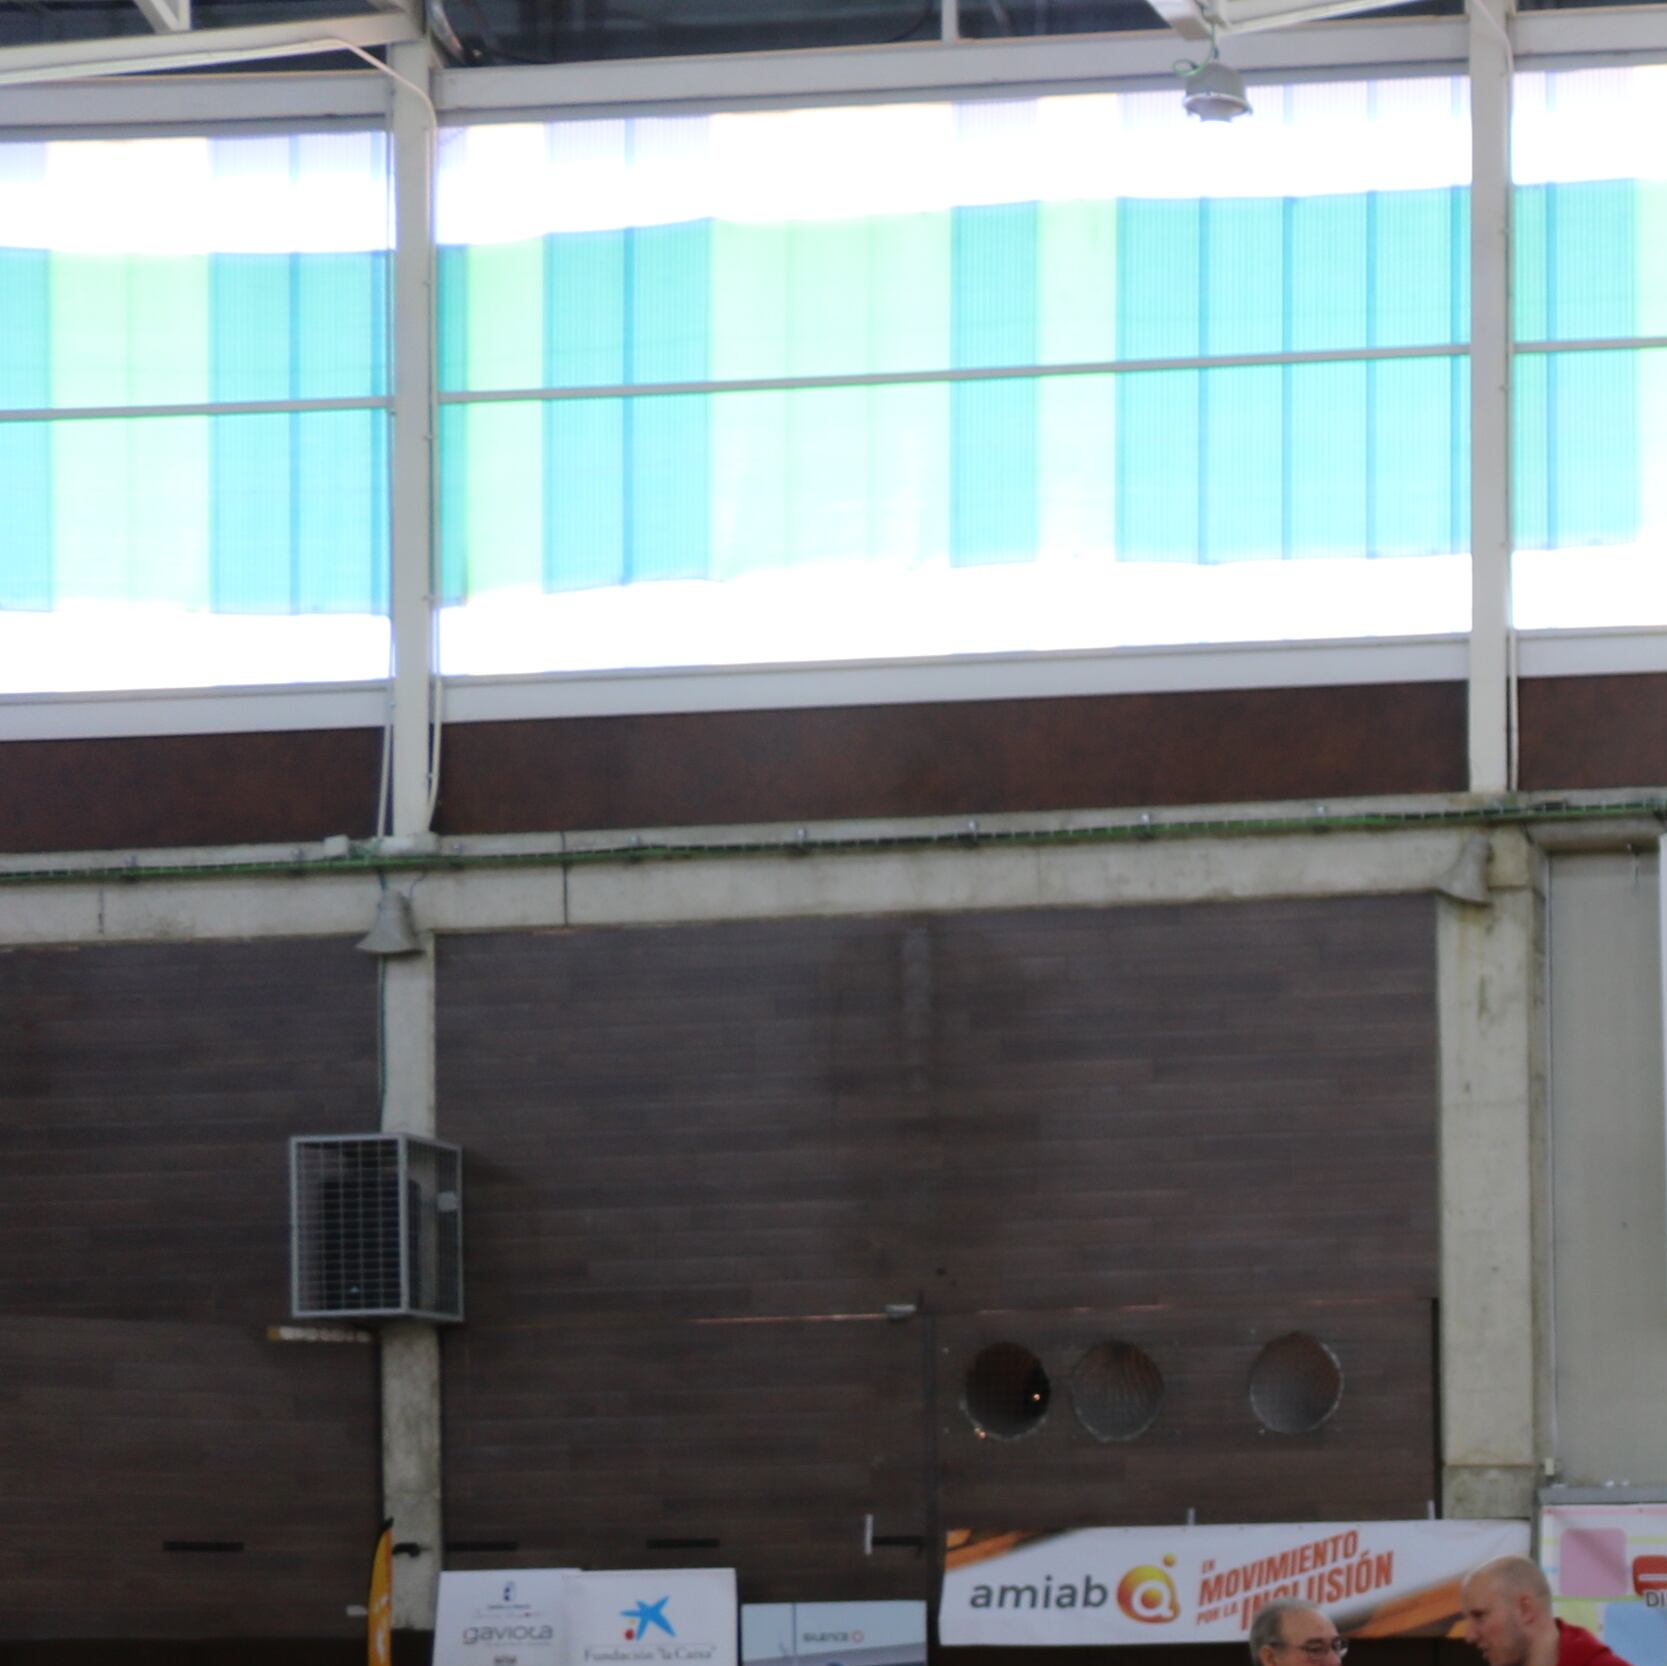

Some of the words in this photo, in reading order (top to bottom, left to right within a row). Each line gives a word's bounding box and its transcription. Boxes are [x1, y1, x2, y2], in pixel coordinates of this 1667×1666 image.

[1198, 1529, 1358, 1607] MOVIMIENTO
[970, 1574, 1109, 1611] amiab
[463, 1624, 554, 1646] gaviota
